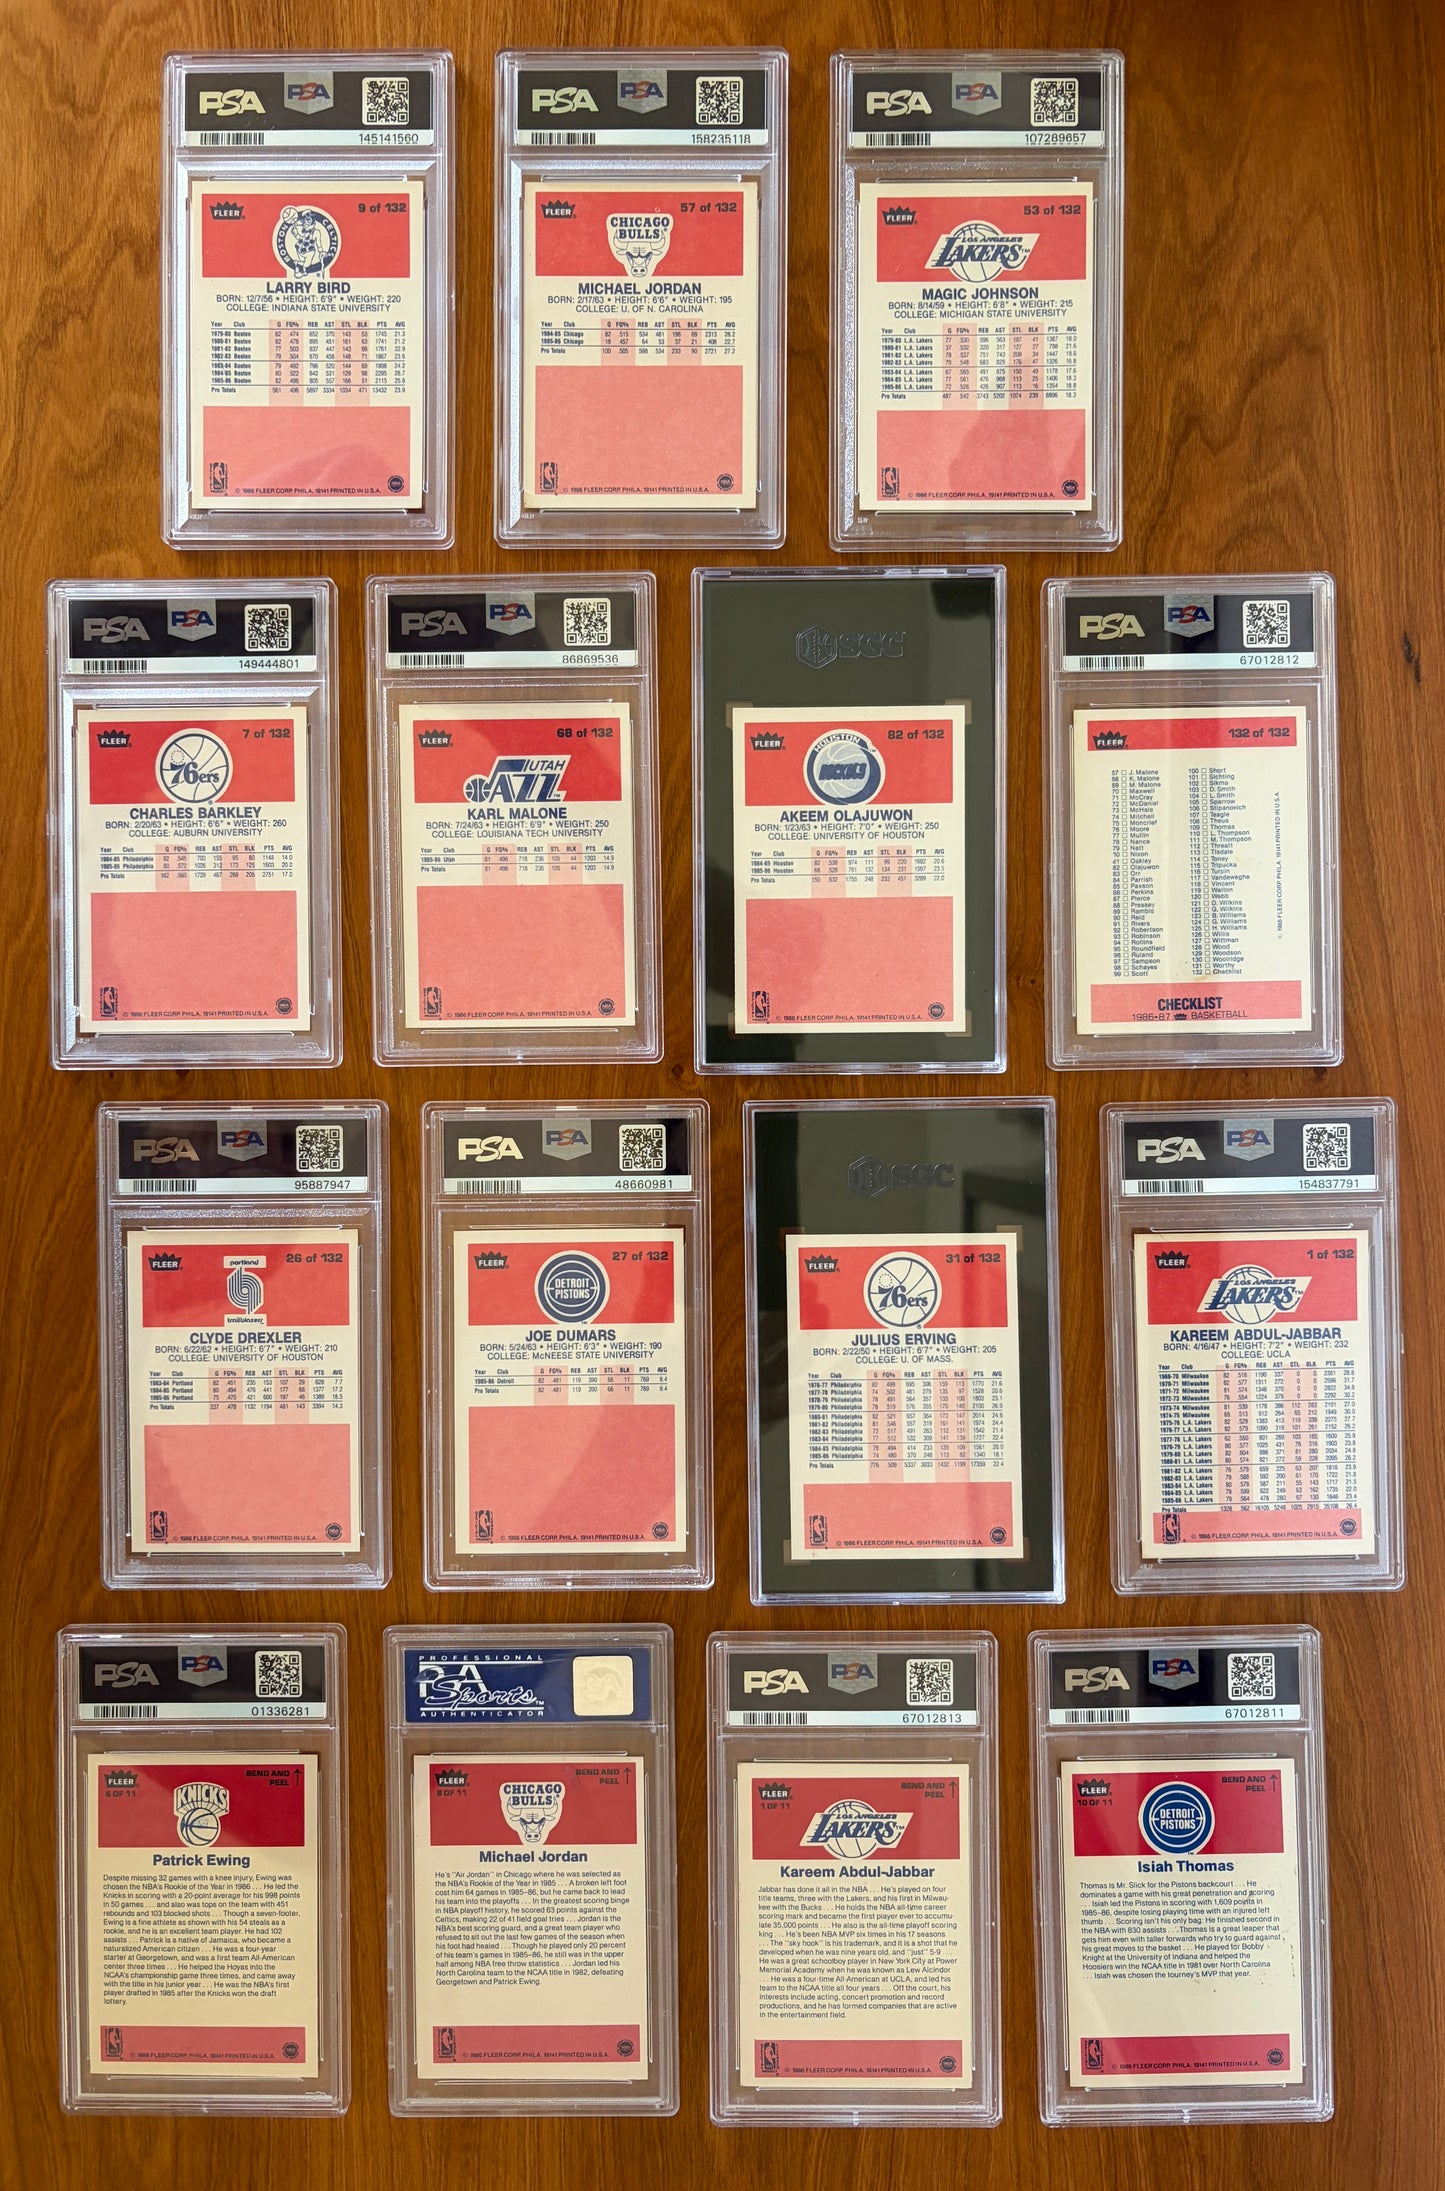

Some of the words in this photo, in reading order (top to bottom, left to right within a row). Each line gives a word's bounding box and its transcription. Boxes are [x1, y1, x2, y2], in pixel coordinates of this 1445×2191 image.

[200, 89, 266, 117] PSA
[532, 87, 599, 114] PSA
[866, 90, 932, 116] PSA
[358, 133, 419, 143] 145141560
[1024, 133, 1086, 143] 107289657
[358, 204, 366, 213] 9
[370, 203, 382, 213] of
[385, 203, 406, 212] 132
[546, 208, 571, 216] FLEER
[680, 202, 695, 213] 57
[700, 202, 712, 212] of
[716, 202, 736, 212] 132
[1024, 206, 1039, 216] 53
[1043, 206, 1055, 215] of
[1058, 205, 1080, 214] 132
[610, 216, 670, 228] CHICAGO
[886, 214, 912, 222] FLEER
[619, 229, 660, 239] BULLS
[266, 282, 312, 293] LARRY
[317, 282, 350, 293] BIRD
[578, 284, 640, 294] MICHAEL
[645, 283, 701, 294] JORDAN
[922, 288, 967, 300] MAGIC
[971, 288, 1039, 299] JOHNSON
[547, 296, 575, 304] BORN:
[578, 296, 604, 304] 2/17/63
[614, 296, 650, 304] HEIGHT:
[680, 296, 718, 304] WEIGHT:
[720, 296, 732, 304] 195
[226, 304, 270, 312] COLLEGE:
[271, 304, 308, 312] INDIANA
[311, 304, 336, 312] STATE
[338, 304, 390, 312] UNIVERSITY
[83, 616, 150, 643] PSA
[401, 611, 468, 638] PSA
[1080, 613, 1146, 640] PSA
[239, 659, 299, 669] 149444801
[562, 654, 618, 664] 86869536
[1240, 655, 1299, 665] 67012812
[242, 730, 250, 738] 7
[254, 729, 266, 738] of
[269, 728, 290, 738] 132
[556, 728, 572, 738] 68
[576, 728, 588, 738] of
[591, 728, 612, 737] 132
[888, 730, 903, 740] 82
[907, 730, 919, 739] of
[922, 730, 944, 739] 132
[1228, 728, 1250, 738] 132
[1253, 728, 1264, 738] of
[1268, 728, 1290, 736] 132
[754, 740, 780, 748] FLEER
[528, 760, 564, 772] UTAH
[170, 761, 220, 785] 76ers
[130, 808, 193, 819] CHARLES
[198, 806, 262, 818] BARKLEY
[468, 808, 504, 820] KARL
[508, 808, 567, 819] MALONE
[780, 810, 829, 822] AKEEM
[834, 810, 912, 822] OLAJUWON
[431, 830, 475, 838] COLLEGE:
[477, 830, 523, 838] LOUISIANA
[526, 830, 549, 838] TECH
[552, 828, 603, 837] UNIVERSITY
[1158, 997, 1222, 1011] CHECKLIST
[1132, 1013, 1170, 1021] 1986-87
[1191, 1010, 1248, 1020] BASKETBALL
[133, 1137, 200, 1164] PSA
[458, 1136, 524, 1162] PSA
[1137, 1136, 1206, 1164] PSA
[294, 1180, 350, 1190] 95887947
[615, 1180, 672, 1190] 48660981
[1299, 1179, 1359, 1189] 154837791
[286, 1254, 302, 1263] 26
[306, 1254, 318, 1263] of
[321, 1253, 342, 1262] 132
[612, 1252, 627, 1261] 27
[632, 1251, 644, 1260] of
[646, 1251, 668, 1260] 132
[946, 1254, 960, 1263] 31
[964, 1254, 975, 1262] of
[978, 1253, 1000, 1262] 132
[1307, 1250, 1313, 1259] 1
[1317, 1250, 1328, 1259] of
[1332, 1249, 1354, 1258] 132
[152, 1260, 178, 1268] FLEER
[809, 1262, 835, 1270] FLEER
[1158, 1258, 1185, 1266] FLEER
[554, 1278, 590, 1288] DETROIT
[555, 1289, 590, 1299] PISTONS
[190, 1332, 235, 1344] CLYDE
[238, 1332, 302, 1343] DREXLER
[526, 1330, 552, 1342] JOE
[556, 1330, 616, 1341] DUMARS
[852, 1334, 900, 1346] JULIUS
[905, 1333, 956, 1344] ERVING
[1170, 1330, 1228, 1341] KAREEM
[1234, 1328, 1341, 1340] ABDUL-JABBAR
[1221, 1350, 1264, 1359] COLLEGE:
[1266, 1350, 1290, 1358] UCLA
[94, 1662, 160, 1688] PSA
[1064, 1666, 1130, 1693] PSA
[744, 1668, 810, 1695] PSA
[252, 1706, 310, 1716] 01336281
[1225, 1708, 1284, 1718] 67012811
[902, 1714, 962, 1724] 67012813
[1222, 1776, 1244, 1784] BEND
[762, 1790, 788, 1798] FLEER
[153, 1854, 203, 1866] Patrick
[206, 1854, 250, 1868] Ewing
[480, 1852, 535, 1862] Michael
[538, 1851, 588, 1862] Jordan
[1138, 1862, 1172, 1872] Isiah
[1176, 1860, 1234, 1872] Thomas
[780, 1866, 835, 1878] Kareem
[839, 1866, 934, 1878] Abdul-Jabbar
[519, 1978, 542, 1986] Ewing.
